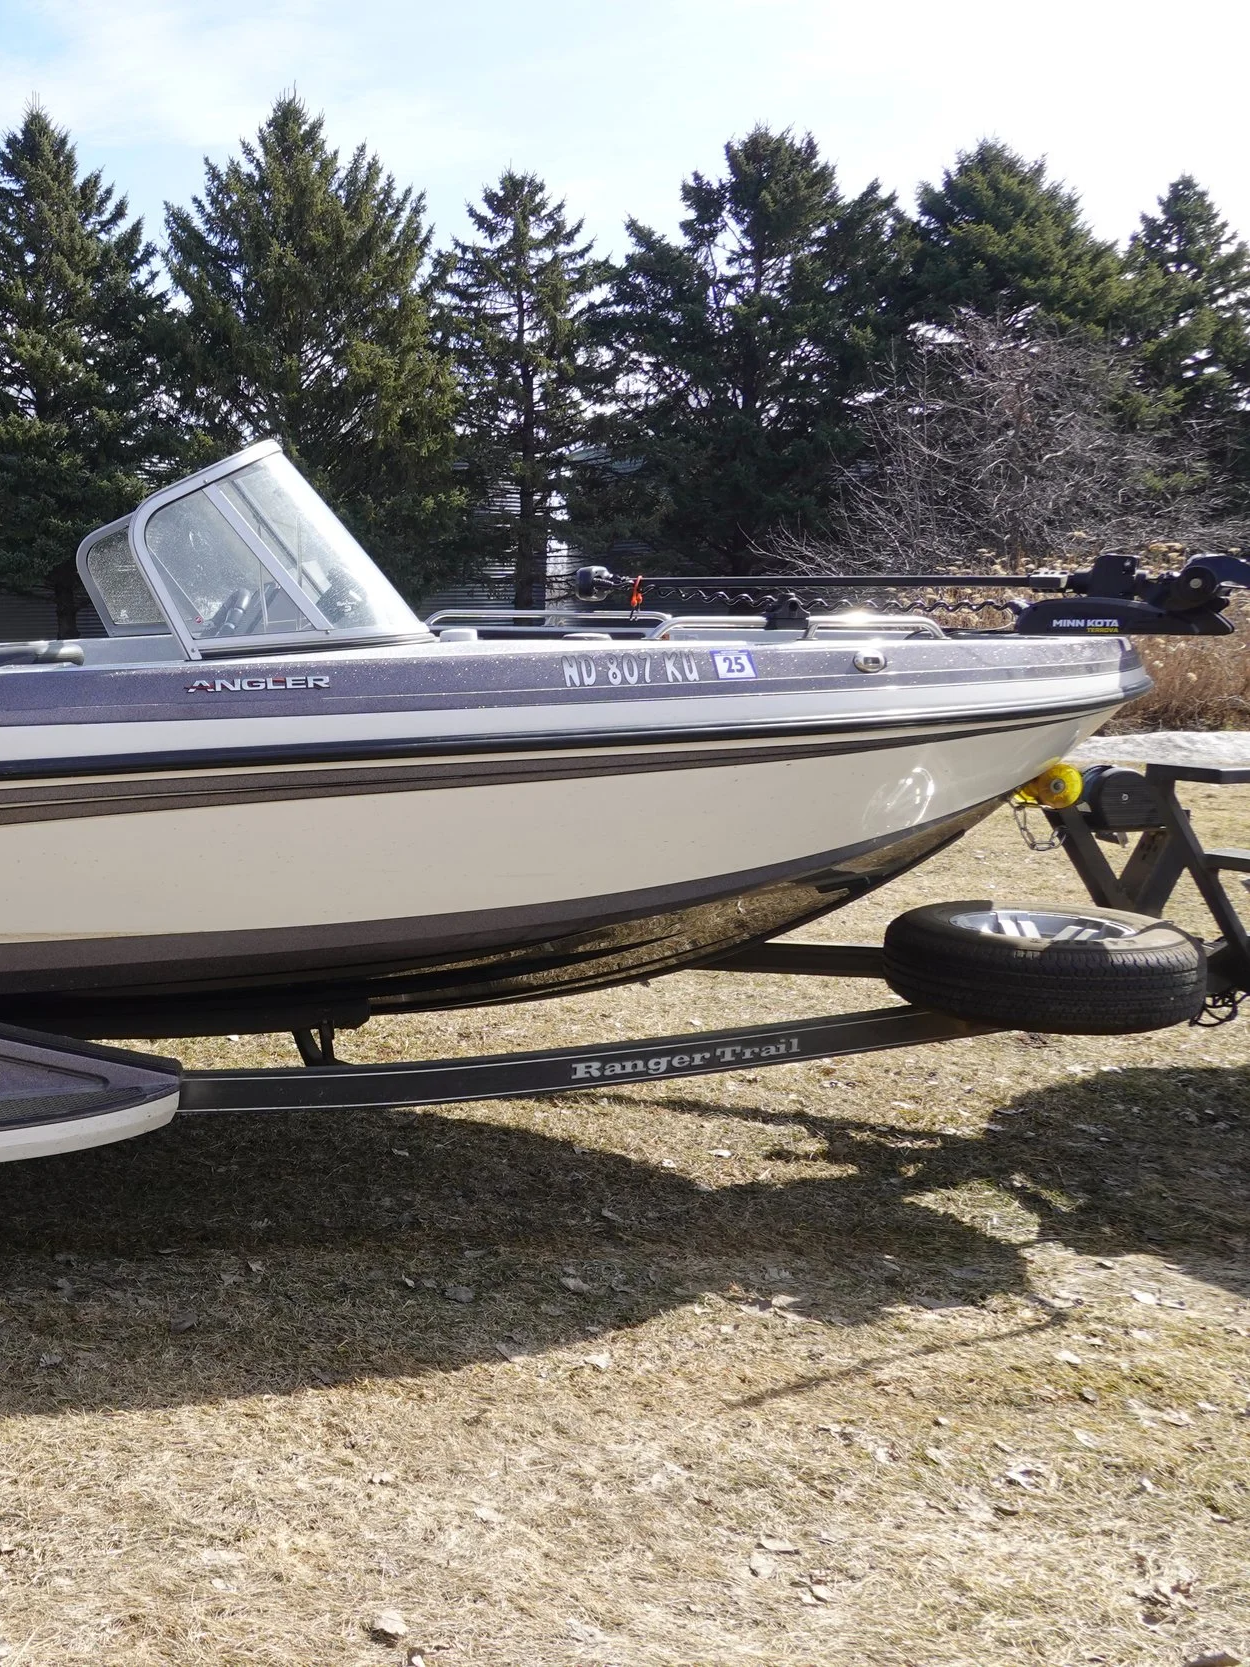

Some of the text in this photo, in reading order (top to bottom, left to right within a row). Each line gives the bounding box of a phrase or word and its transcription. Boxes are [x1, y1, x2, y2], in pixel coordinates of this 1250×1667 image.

[1052, 619, 1120, 628] MINN KOTA
[561, 650, 700, 687] ND 807 KU
[722, 656, 746, 674] 25
[186, 675, 331, 694] ANGLER
[570, 1037, 801, 1080] Ranger Trail
